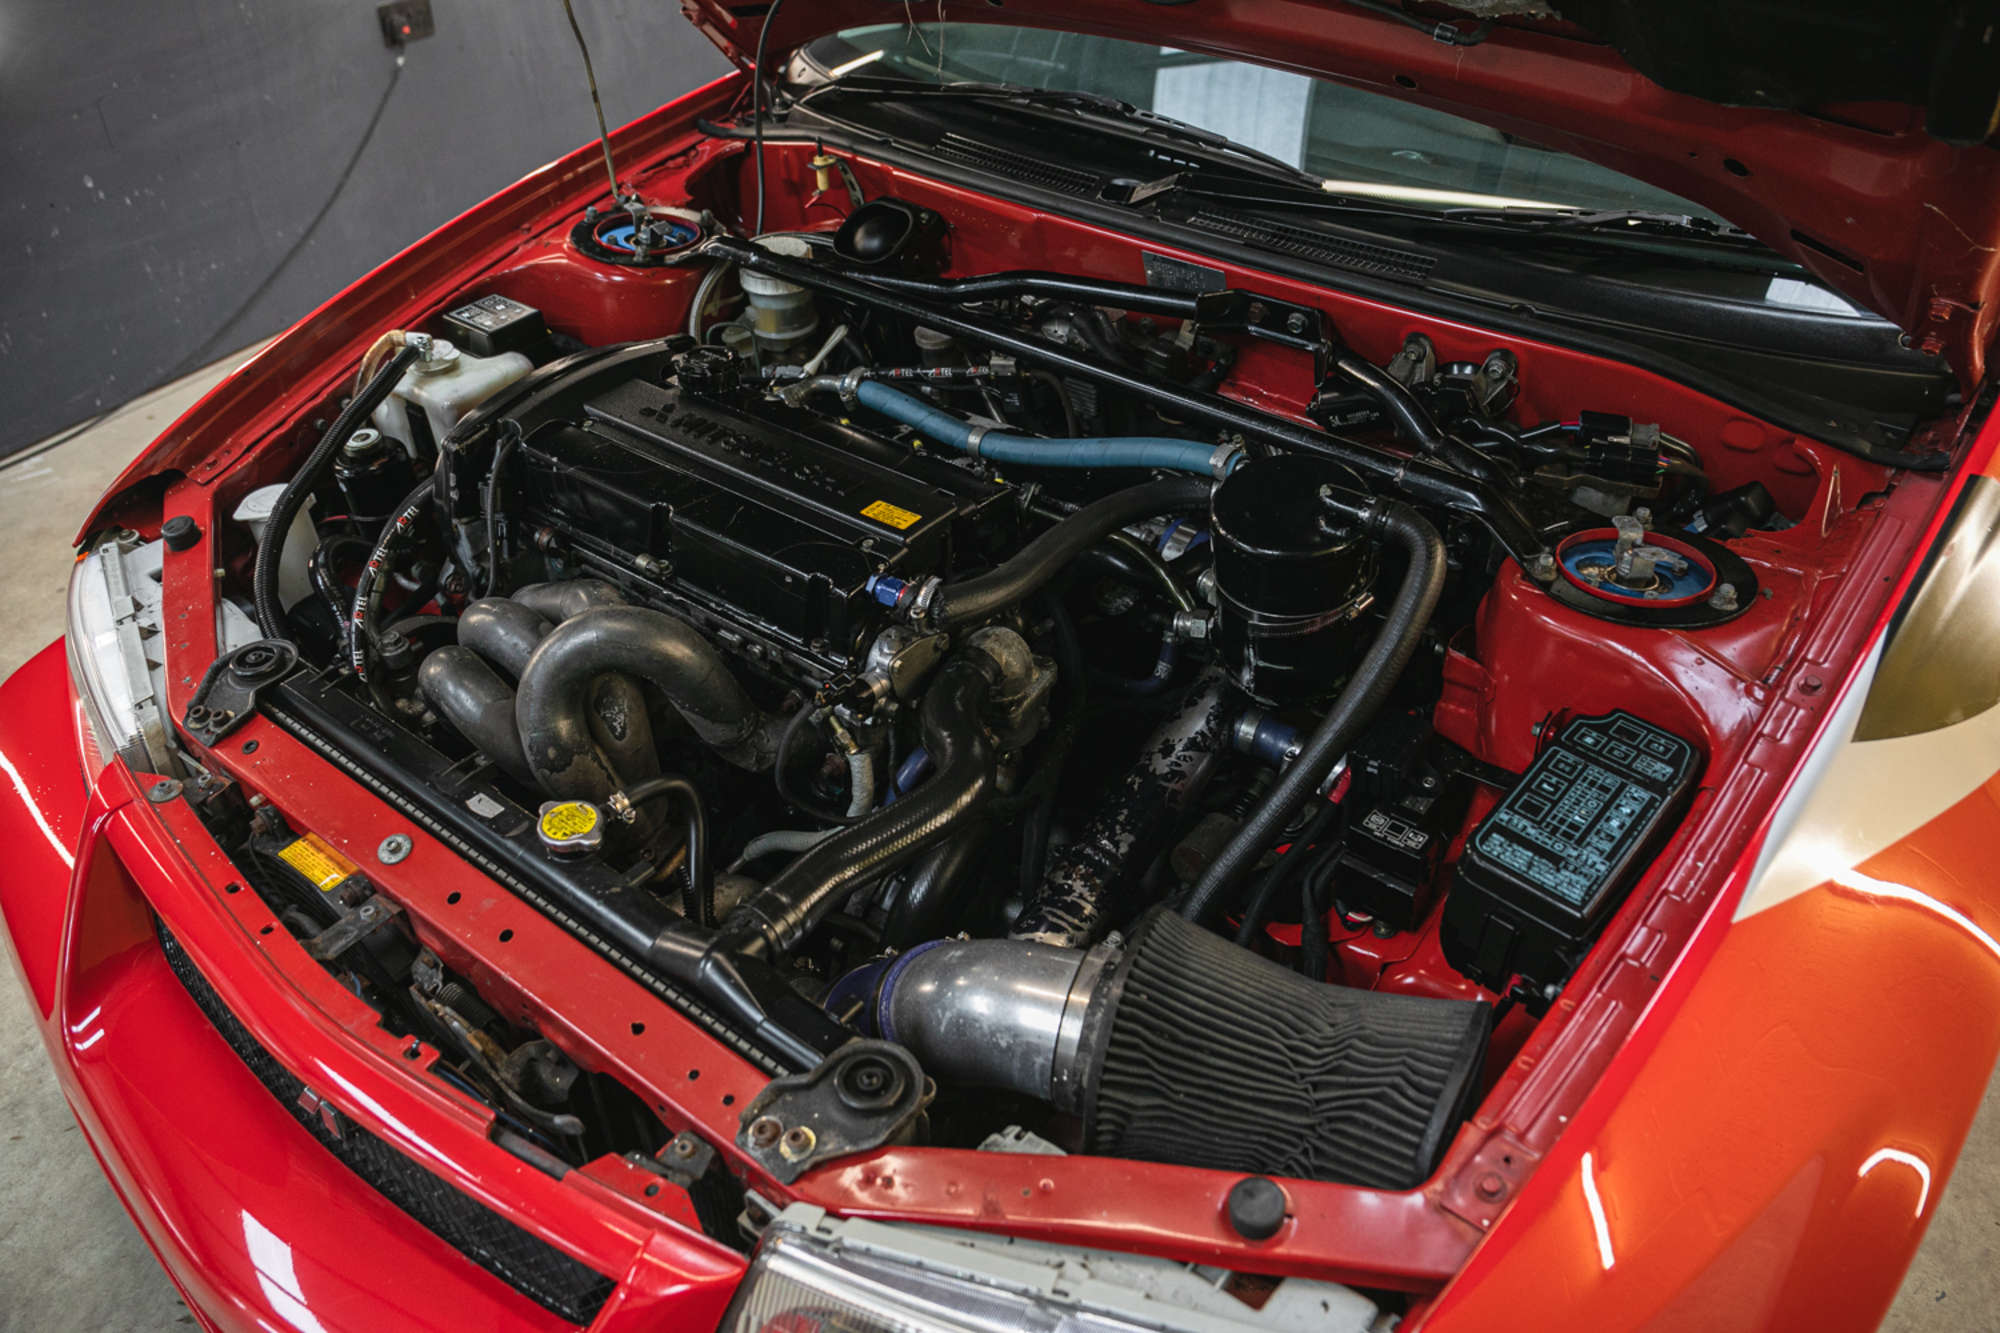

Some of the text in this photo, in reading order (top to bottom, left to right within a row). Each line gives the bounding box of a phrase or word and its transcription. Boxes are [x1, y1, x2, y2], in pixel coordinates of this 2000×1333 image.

[888, 368, 914, 377] ARTEL
[928, 367, 952, 377] ARTEL
[353, 596, 368, 630] ARTEL
[368, 547, 388, 578] ARTEL
[396, 505, 419, 534] ARTEL
